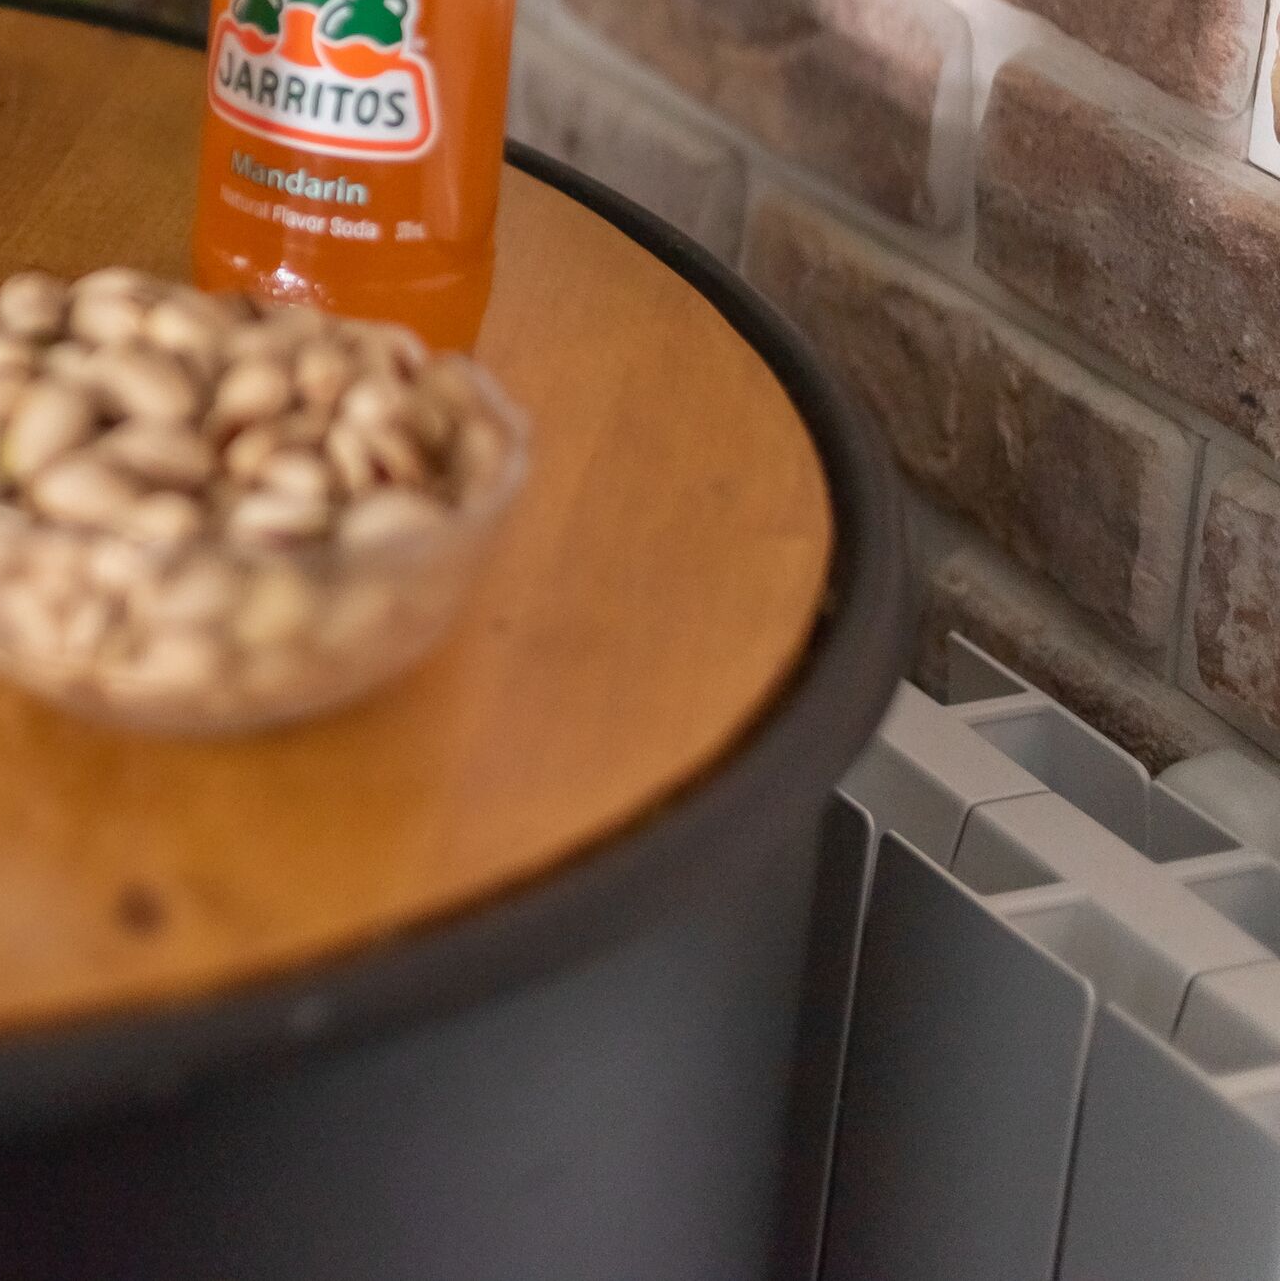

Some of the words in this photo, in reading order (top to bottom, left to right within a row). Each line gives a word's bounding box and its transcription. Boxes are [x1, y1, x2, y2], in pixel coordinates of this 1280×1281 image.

[218, 52, 406, 128] JARRITOS
[231, 149, 370, 207] Mandarin
[272, 203, 326, 234] Flavor
[329, 216, 380, 241] Soda
